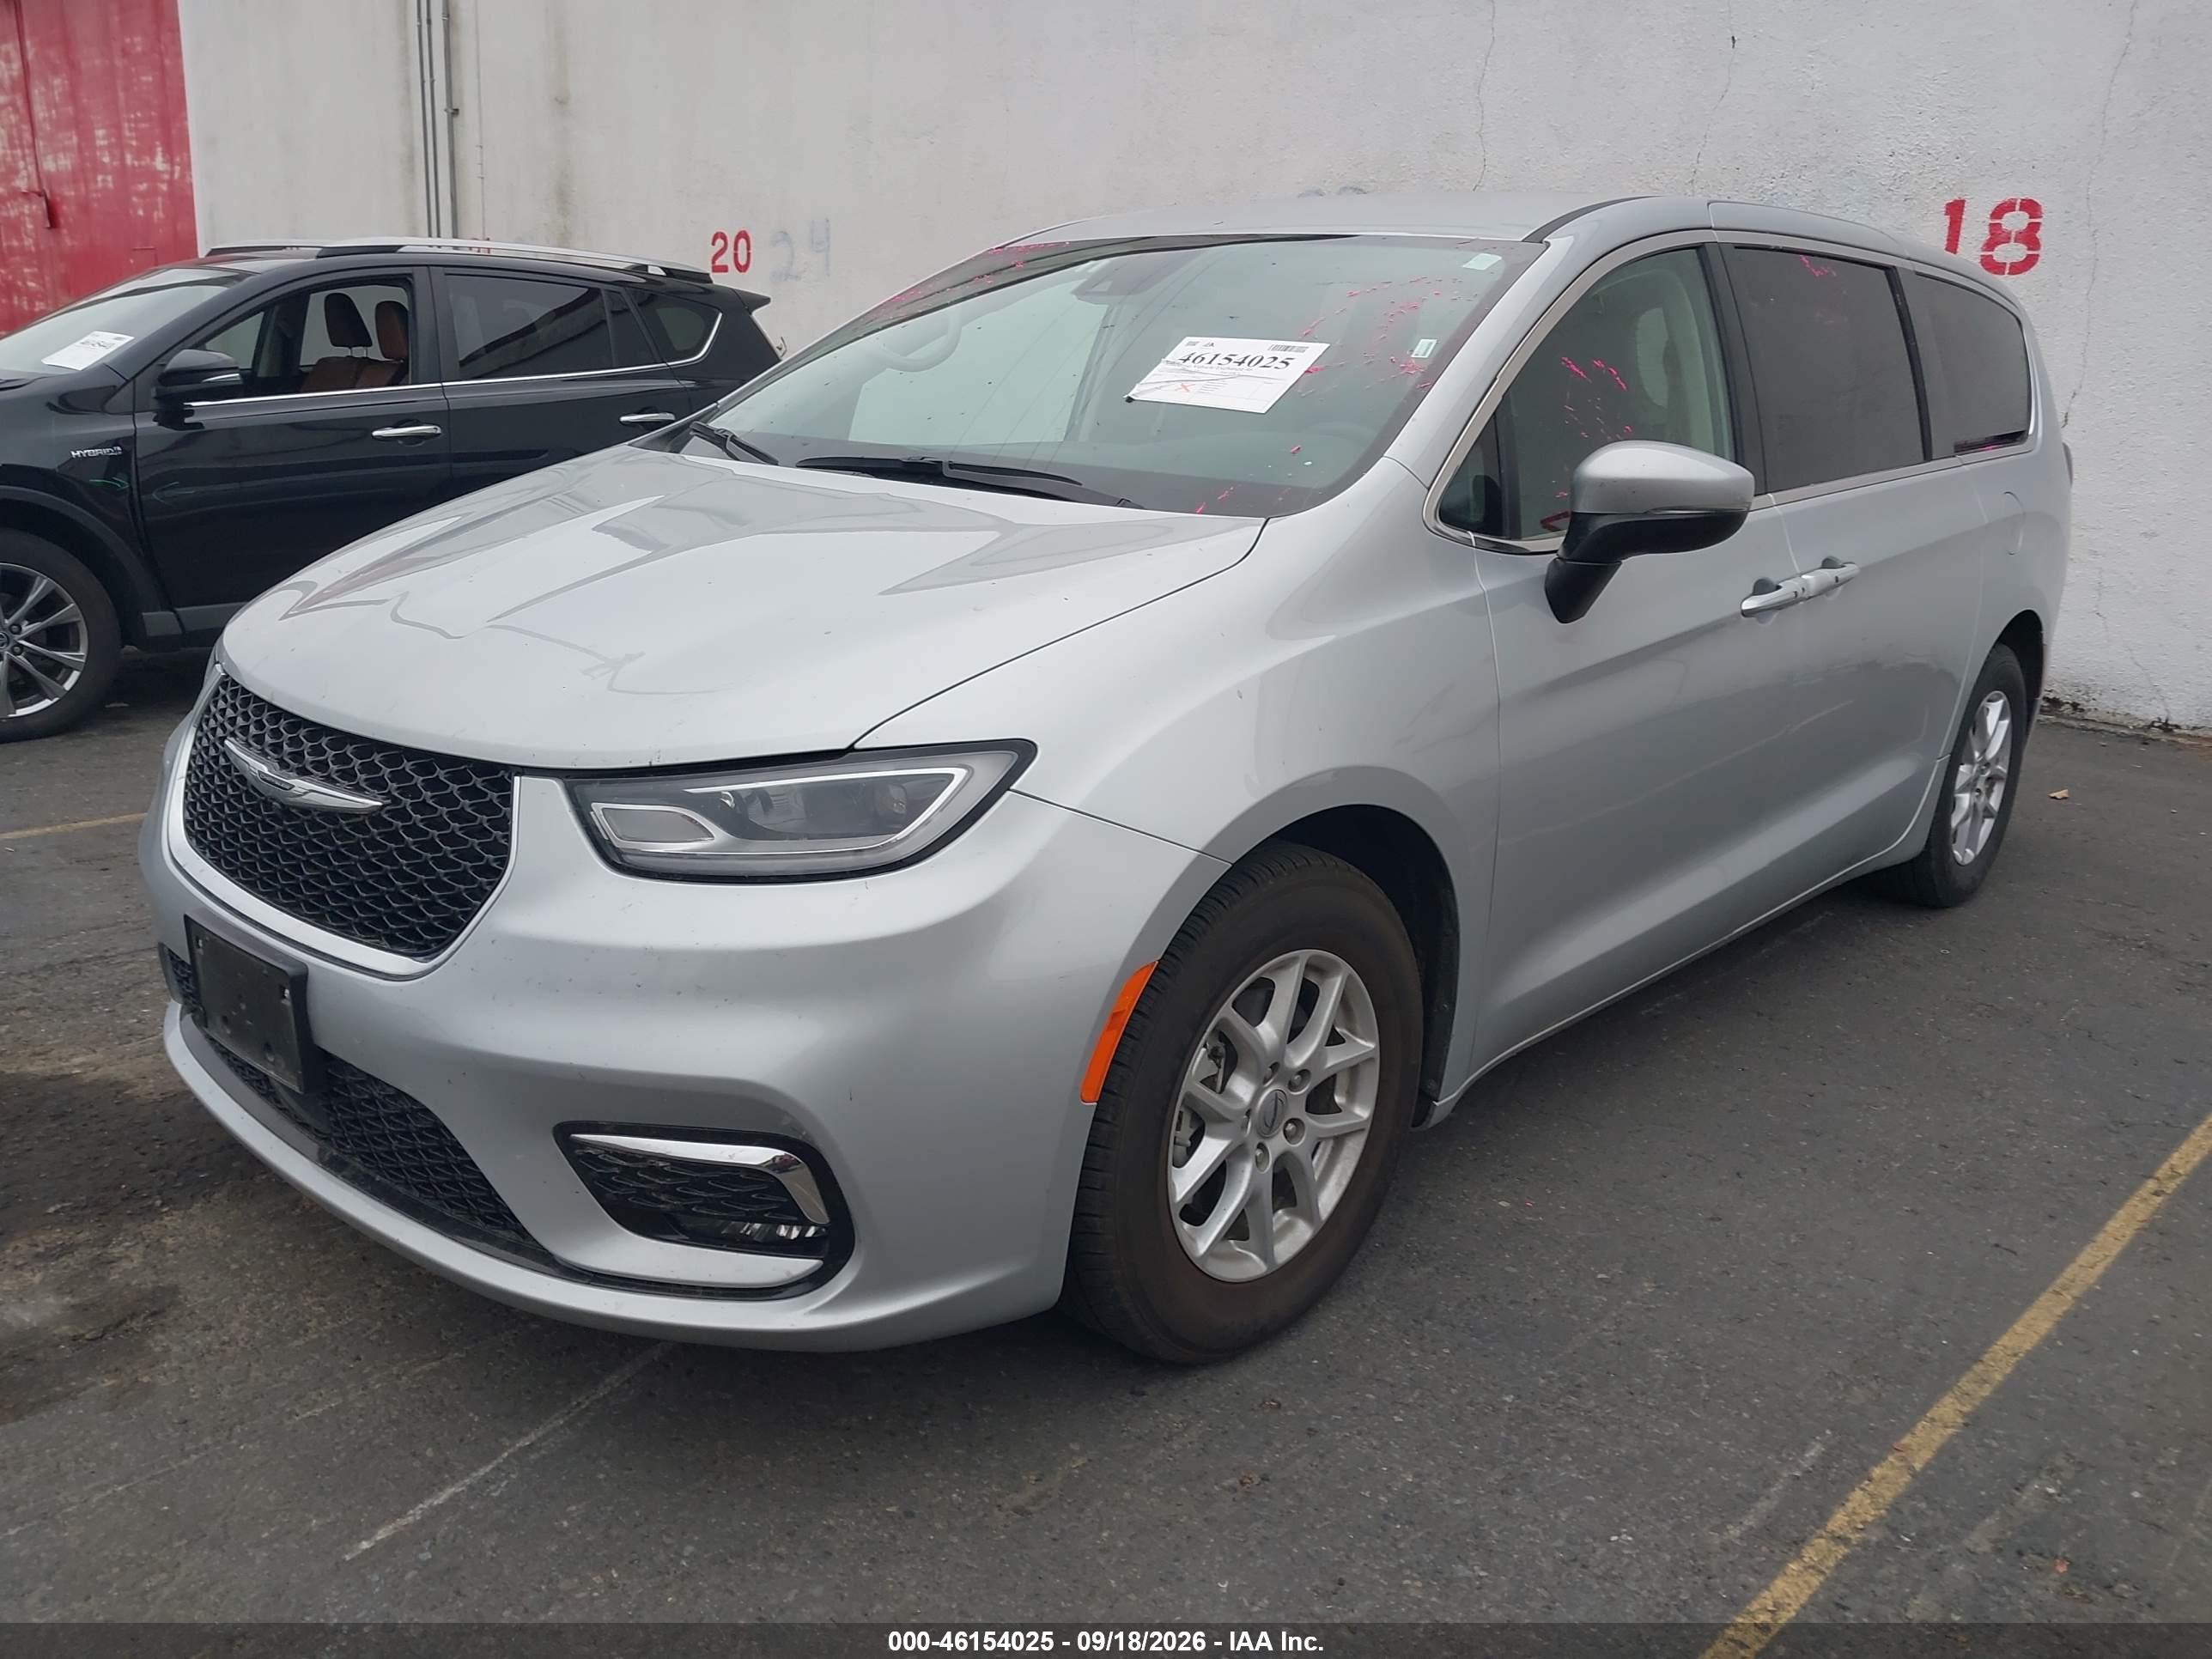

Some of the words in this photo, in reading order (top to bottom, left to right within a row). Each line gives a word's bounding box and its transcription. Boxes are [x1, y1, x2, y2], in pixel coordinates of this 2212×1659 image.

[711, 230, 751, 273] 20
[1944, 197, 2044, 276] 18
[1179, 352, 1295, 369] 46154025
